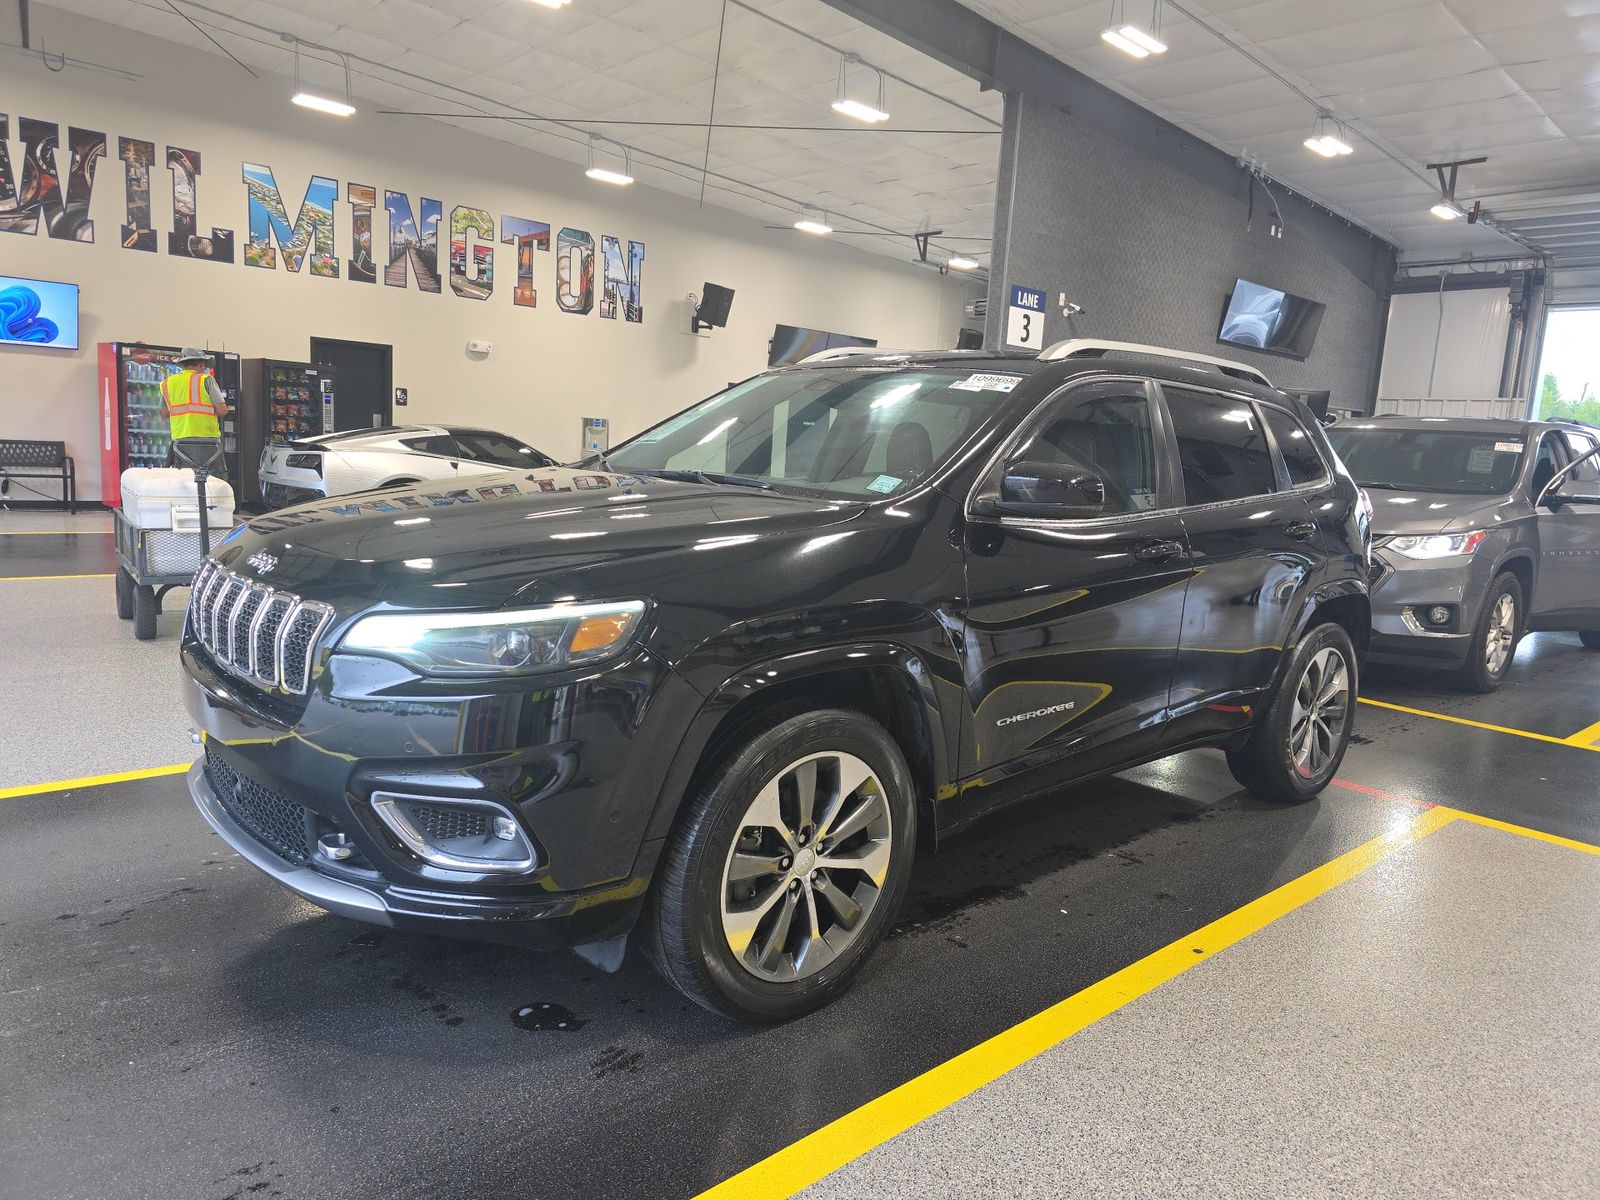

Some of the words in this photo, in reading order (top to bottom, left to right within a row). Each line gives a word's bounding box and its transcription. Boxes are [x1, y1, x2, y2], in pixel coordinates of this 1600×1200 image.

[0, 112, 645, 323] WILMINGTON
[1017, 290, 1039, 308] LANE
[1020, 313, 1031, 343] 3
[996, 701, 1075, 727] CHEROKEE
